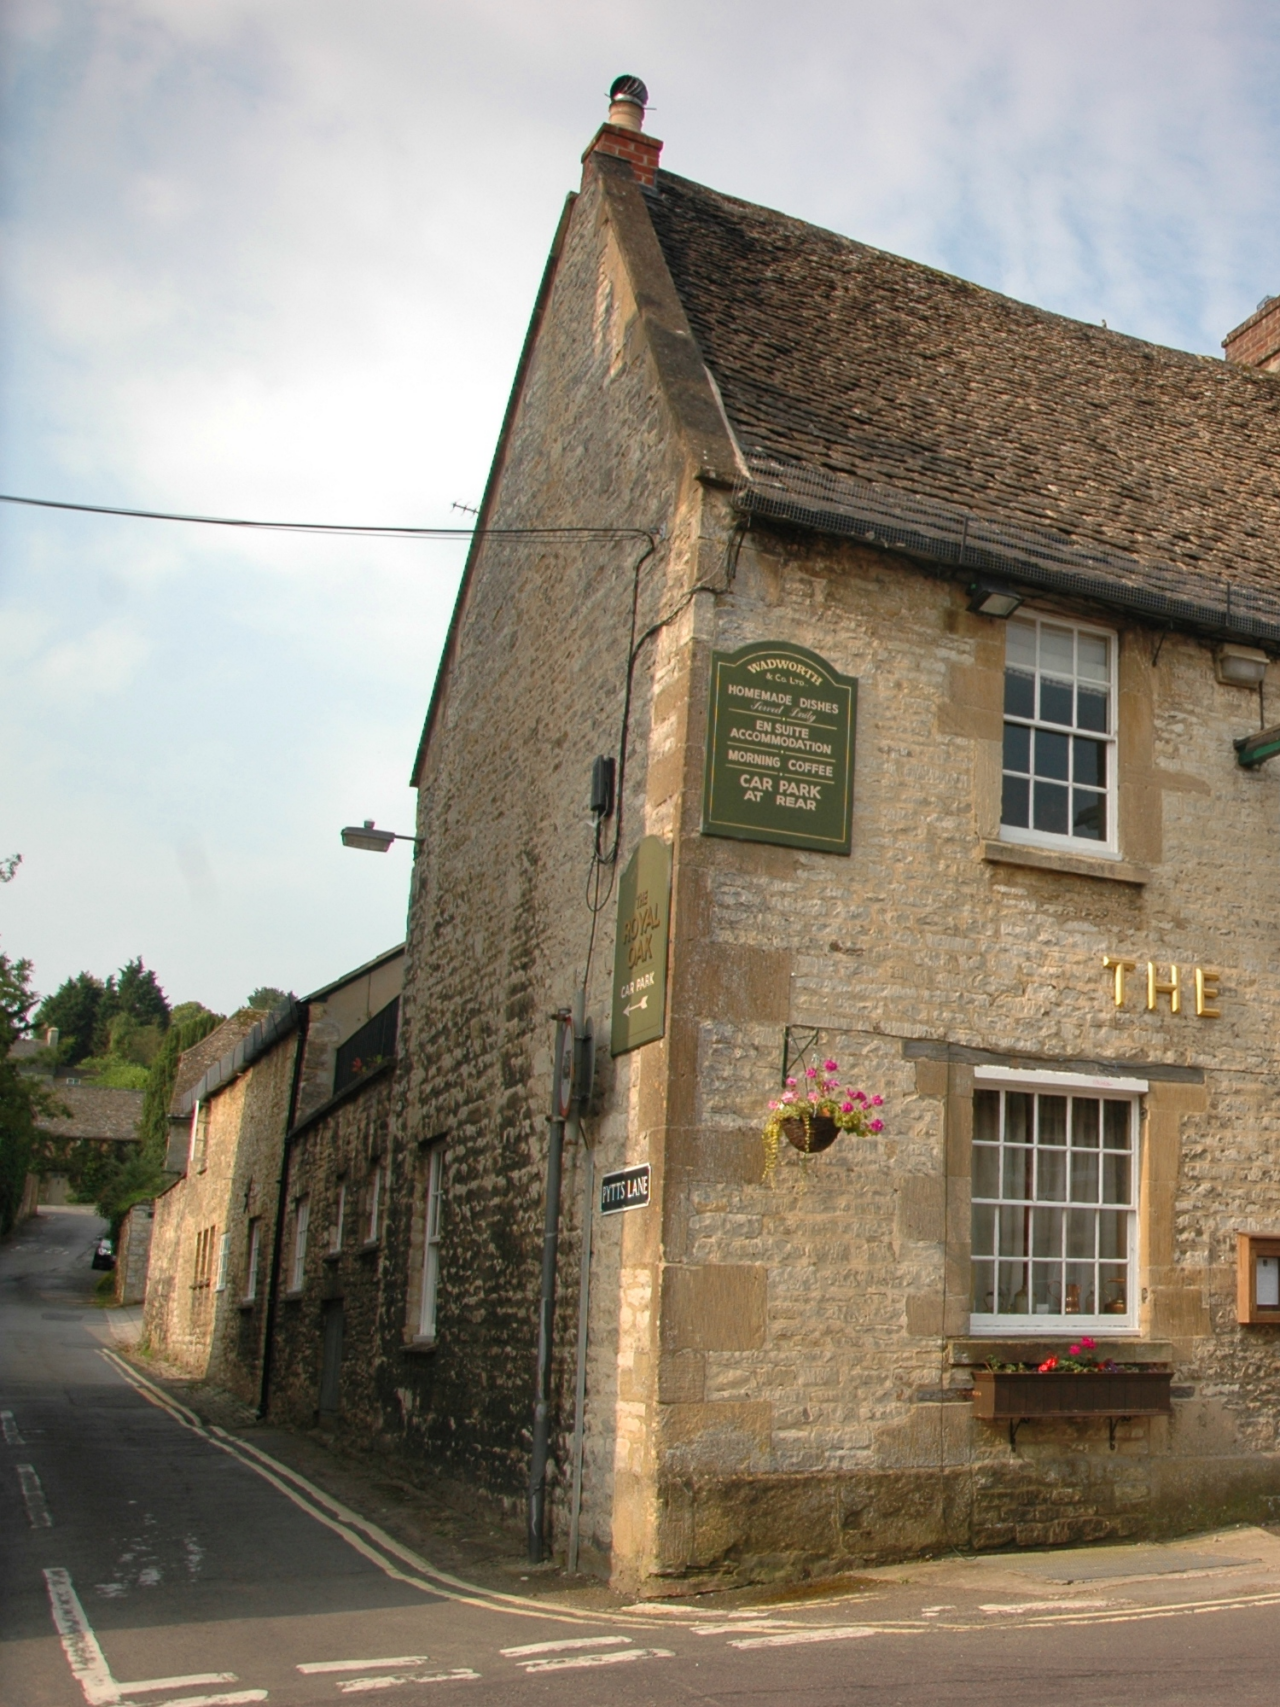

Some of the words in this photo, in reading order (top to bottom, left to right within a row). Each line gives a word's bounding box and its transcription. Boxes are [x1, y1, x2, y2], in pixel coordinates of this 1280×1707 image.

[747, 658, 823, 686] WADWORTH
[766, 672, 773, 680] &
[728, 684, 792, 705] HOMEMADE
[800, 698, 839, 714] DISHES
[730, 728, 832, 754] ACCOMMODATION
[756, 720, 772, 732] EN
[774, 722, 809, 738] SUITE
[728, 750, 780, 768] MORNING
[788, 760, 833, 777] COFFEE
[740, 774, 772, 791] CAR
[780, 780, 822, 800] PARK
[744, 790, 764, 802] AT
[776, 795, 816, 811] REAR
[636, 890, 648, 910] THE
[624, 903, 660, 945] ROYAL
[629, 934, 652, 970] OAK
[620, 981, 634, 998] CAR
[636, 971, 654, 992] PARK
[1103, 956, 1221, 1018] THE
[602, 1181, 625, 1203] PYTTS
[628, 1176, 648, 1198] LANE
